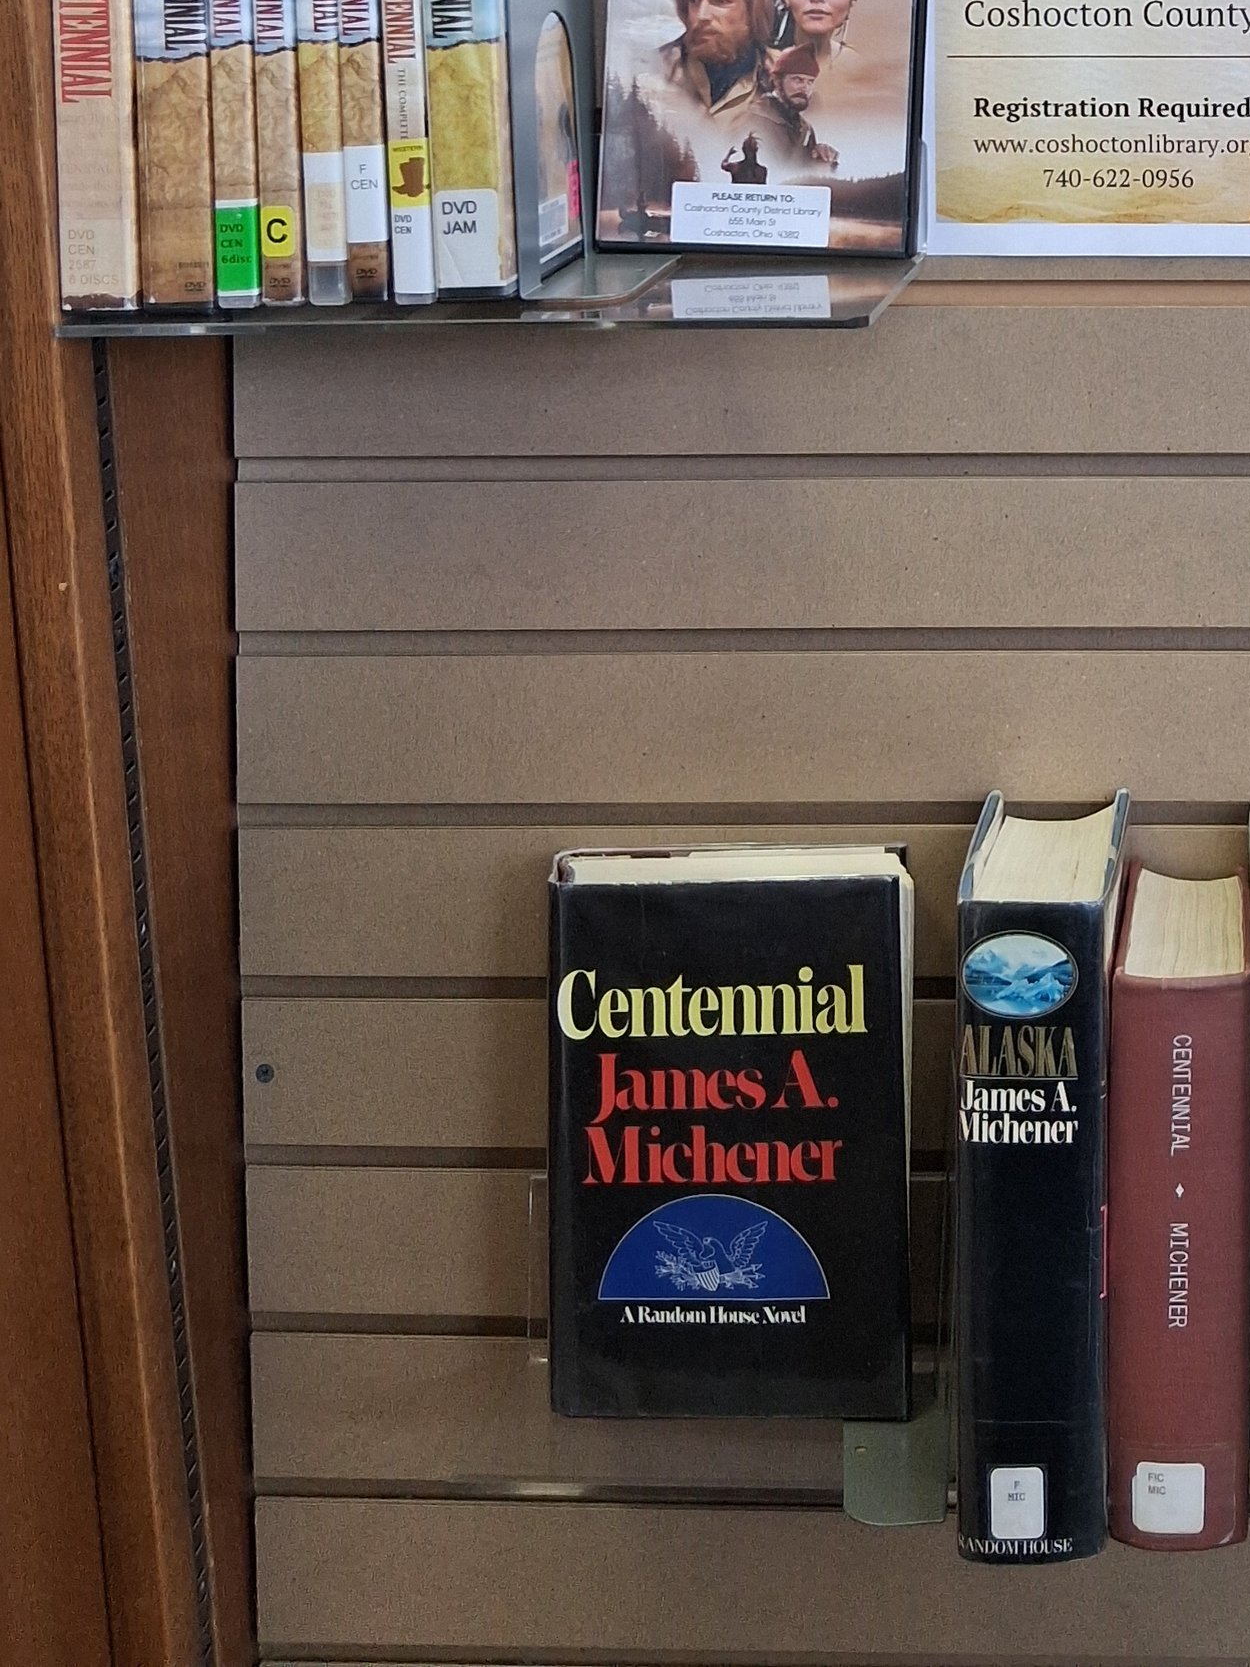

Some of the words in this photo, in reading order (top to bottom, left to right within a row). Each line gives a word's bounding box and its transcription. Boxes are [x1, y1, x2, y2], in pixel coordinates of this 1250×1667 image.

[973, 96, 1131, 123] Registration
[359, 163, 367, 175] F
[1042, 168, 1194, 189] 740-622-0956
[351, 178, 379, 191] CEN
[441, 200, 478, 216] DVD
[711, 192, 745, 202] PLEASE
[745, 193, 778, 203] RETURN
[219, 224, 243, 234] DVD
[266, 218, 288, 244] C
[442, 220, 478, 236] JAM
[220, 239, 243, 249] CEN
[557, 964, 868, 1040] Centennial
[960, 1024, 1079, 1077] ALASKA
[597, 1050, 768, 1124] James
[772, 1050, 840, 1111] A.
[960, 1080, 1046, 1112] James
[1050, 1081, 1078, 1112] A.
[1170, 1034, 1193, 1157] CENTENNIAL
[959, 1110, 1079, 1145] Michener
[583, 1125, 843, 1185] Michener
[1168, 1222, 1189, 1329] MICHENER
[620, 1305, 636, 1325] A
[637, 1305, 707, 1325] Random
[709, 1305, 760, 1325] House
[762, 1304, 807, 1325] Novel
[1147, 1472, 1165, 1483] FIC
[1147, 1485, 1167, 1496] MIC
[1021, 1537, 1073, 1556] HOUSE
